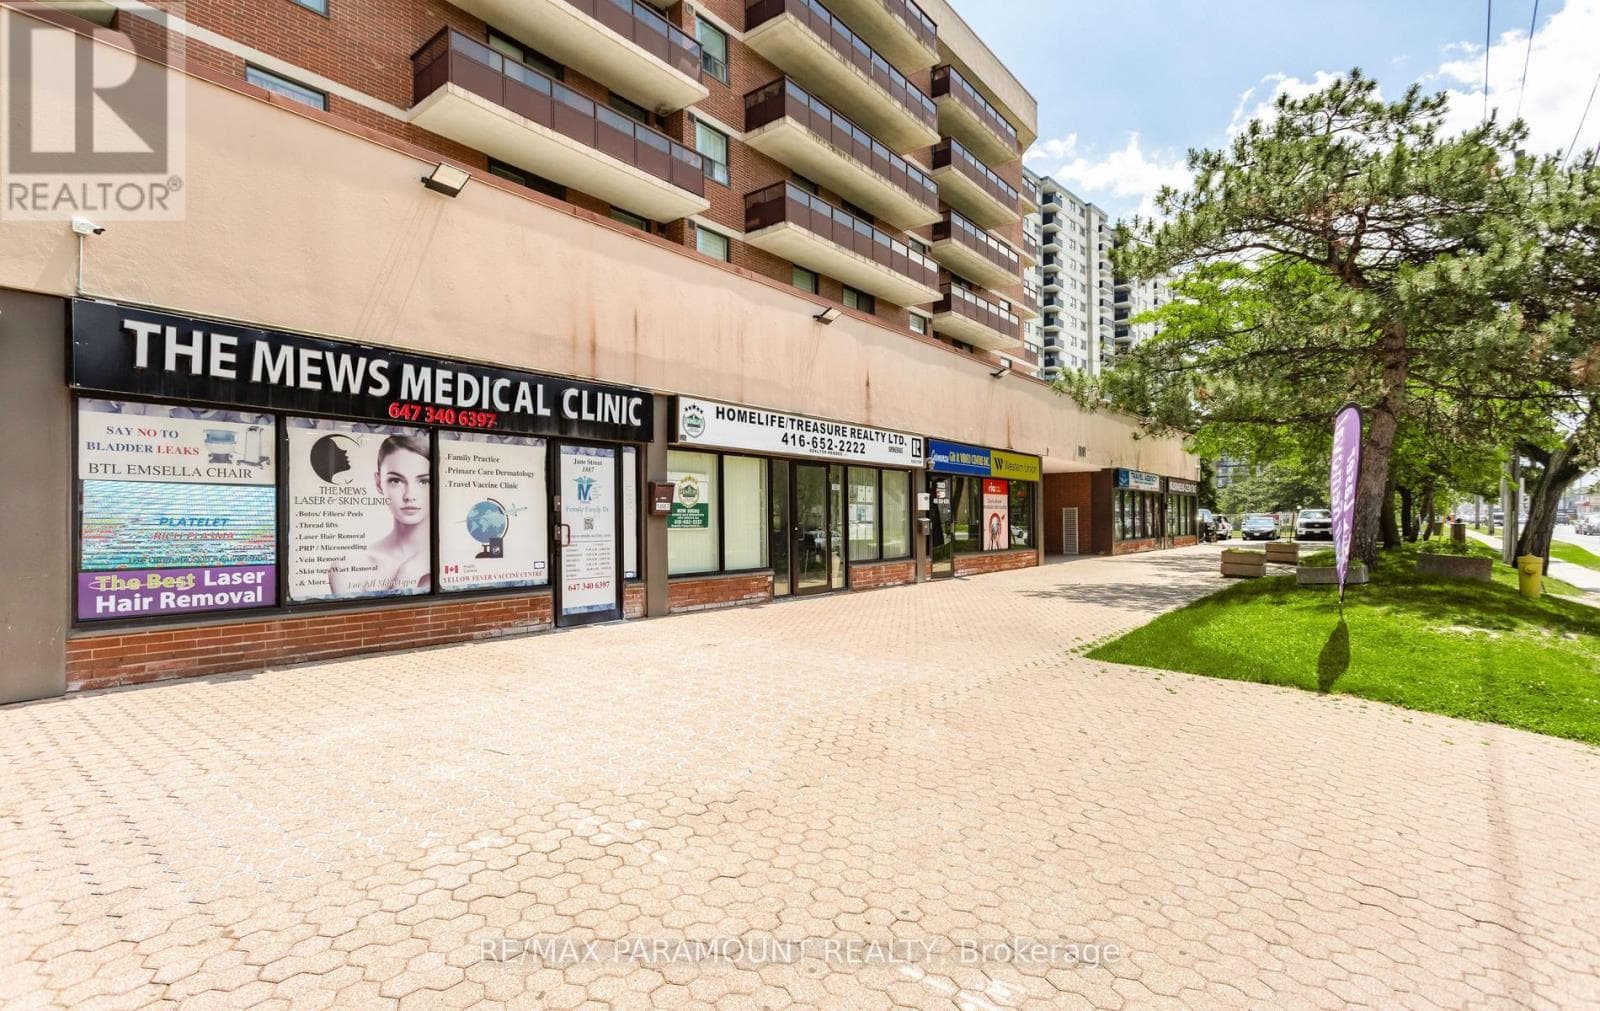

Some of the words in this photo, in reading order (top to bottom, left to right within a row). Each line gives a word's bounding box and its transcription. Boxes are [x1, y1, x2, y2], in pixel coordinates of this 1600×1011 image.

[122, 319, 238, 379] THE
[252, 340, 391, 397] MEWS
[401, 364, 551, 417] MEDICAL
[562, 388, 643, 427] CLINIC
[388, 402, 421, 421] 647
[425, 407, 455, 425] 340
[458, 411, 497, 428] 6397
[106, 426, 134, 436] SAY
[137, 428, 157, 438] NO
[160, 429, 179, 438] TO
[715, 406, 848, 438] HOMELIFE/TREASURE
[850, 426, 887, 443] REALTY
[888, 433, 908, 446] LTD.
[86, 441, 153, 453] BLADDER
[156, 445, 199, 456] LEAKS
[781, 432, 866, 455] 416-652-2222
[447, 453, 471, 463] Family
[473, 455, 500, 463] Practice
[88, 462, 122, 474] BTL
[127, 464, 202, 477] EMSELLA
[206, 467, 252, 479] CHAIR
[495, 469, 535, 478] Dermatology
[320, 486, 338, 495] THE
[339, 487, 367, 495] MEWS
[447, 480, 471, 488] Travel
[472, 481, 498, 489] Vaccine
[294, 496, 326, 505] LASER
[338, 496, 360, 505] SKIN
[360, 497, 393, 505] CLINIC
[159, 517, 230, 527] PLATELET
[337, 532, 366, 540] Removal
[350, 565, 379, 573] Removal
[94, 575, 141, 591] The
[147, 573, 196, 590] Best
[204, 570, 266, 587] Laser
[567, 583, 580, 592] 647
[581, 582, 594, 591] 340
[594, 580, 610, 589] 6397
[96, 593, 153, 613] Hair
[160, 586, 263, 609] Removal
